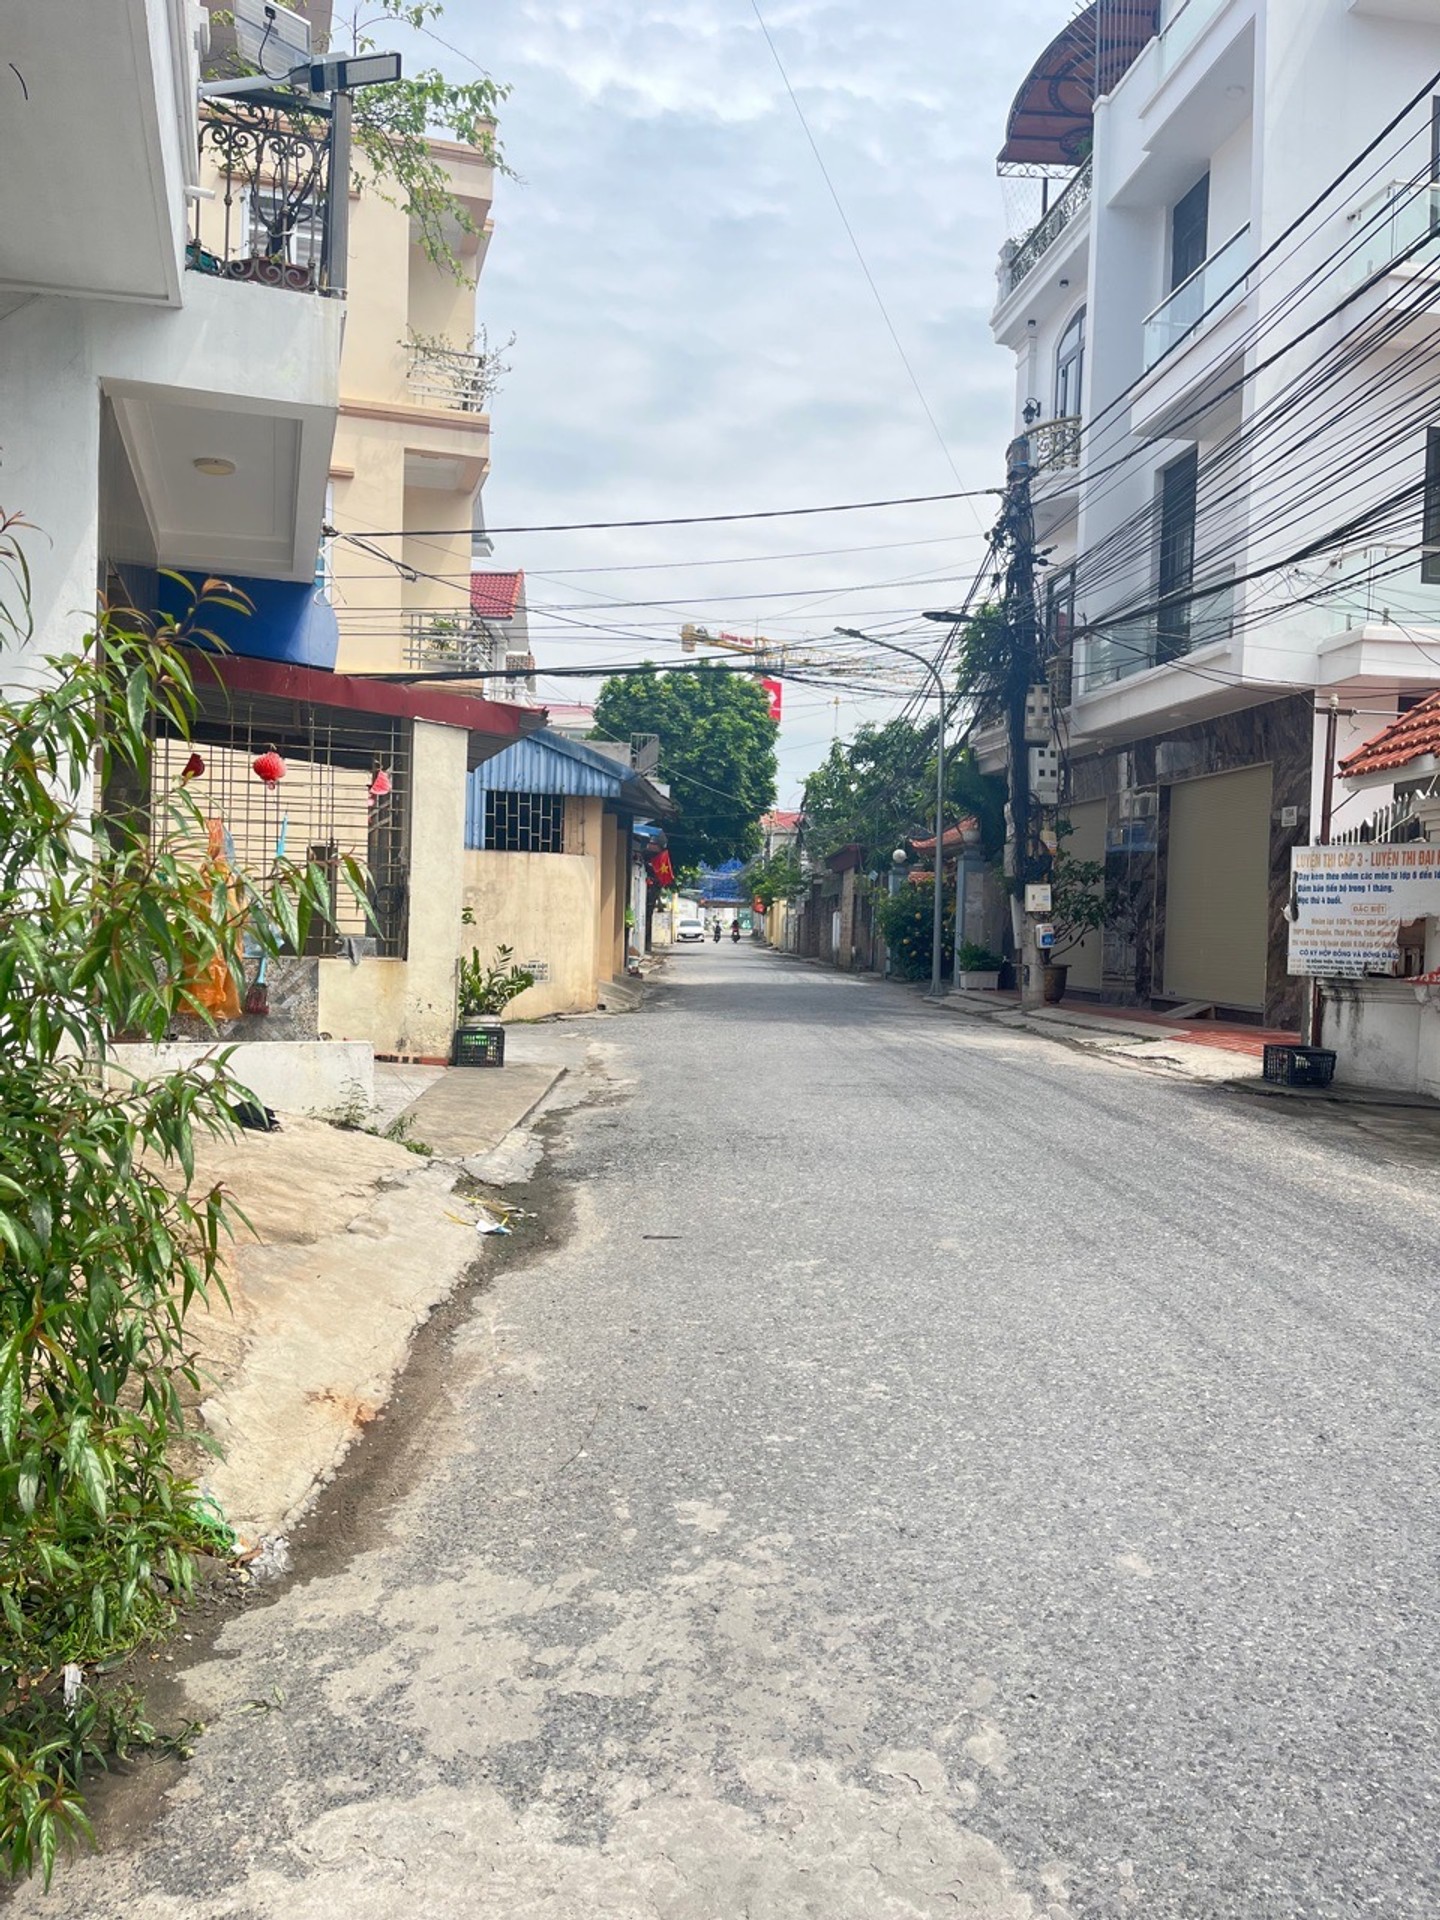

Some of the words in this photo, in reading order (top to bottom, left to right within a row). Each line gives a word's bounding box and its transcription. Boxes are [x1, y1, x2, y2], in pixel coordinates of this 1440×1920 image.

[1323, 853, 1335, 867] THI
[1357, 852, 1364, 867] 3
[1371, 848, 1399, 870] LUYỆN
[1402, 851, 1415, 866] THI
